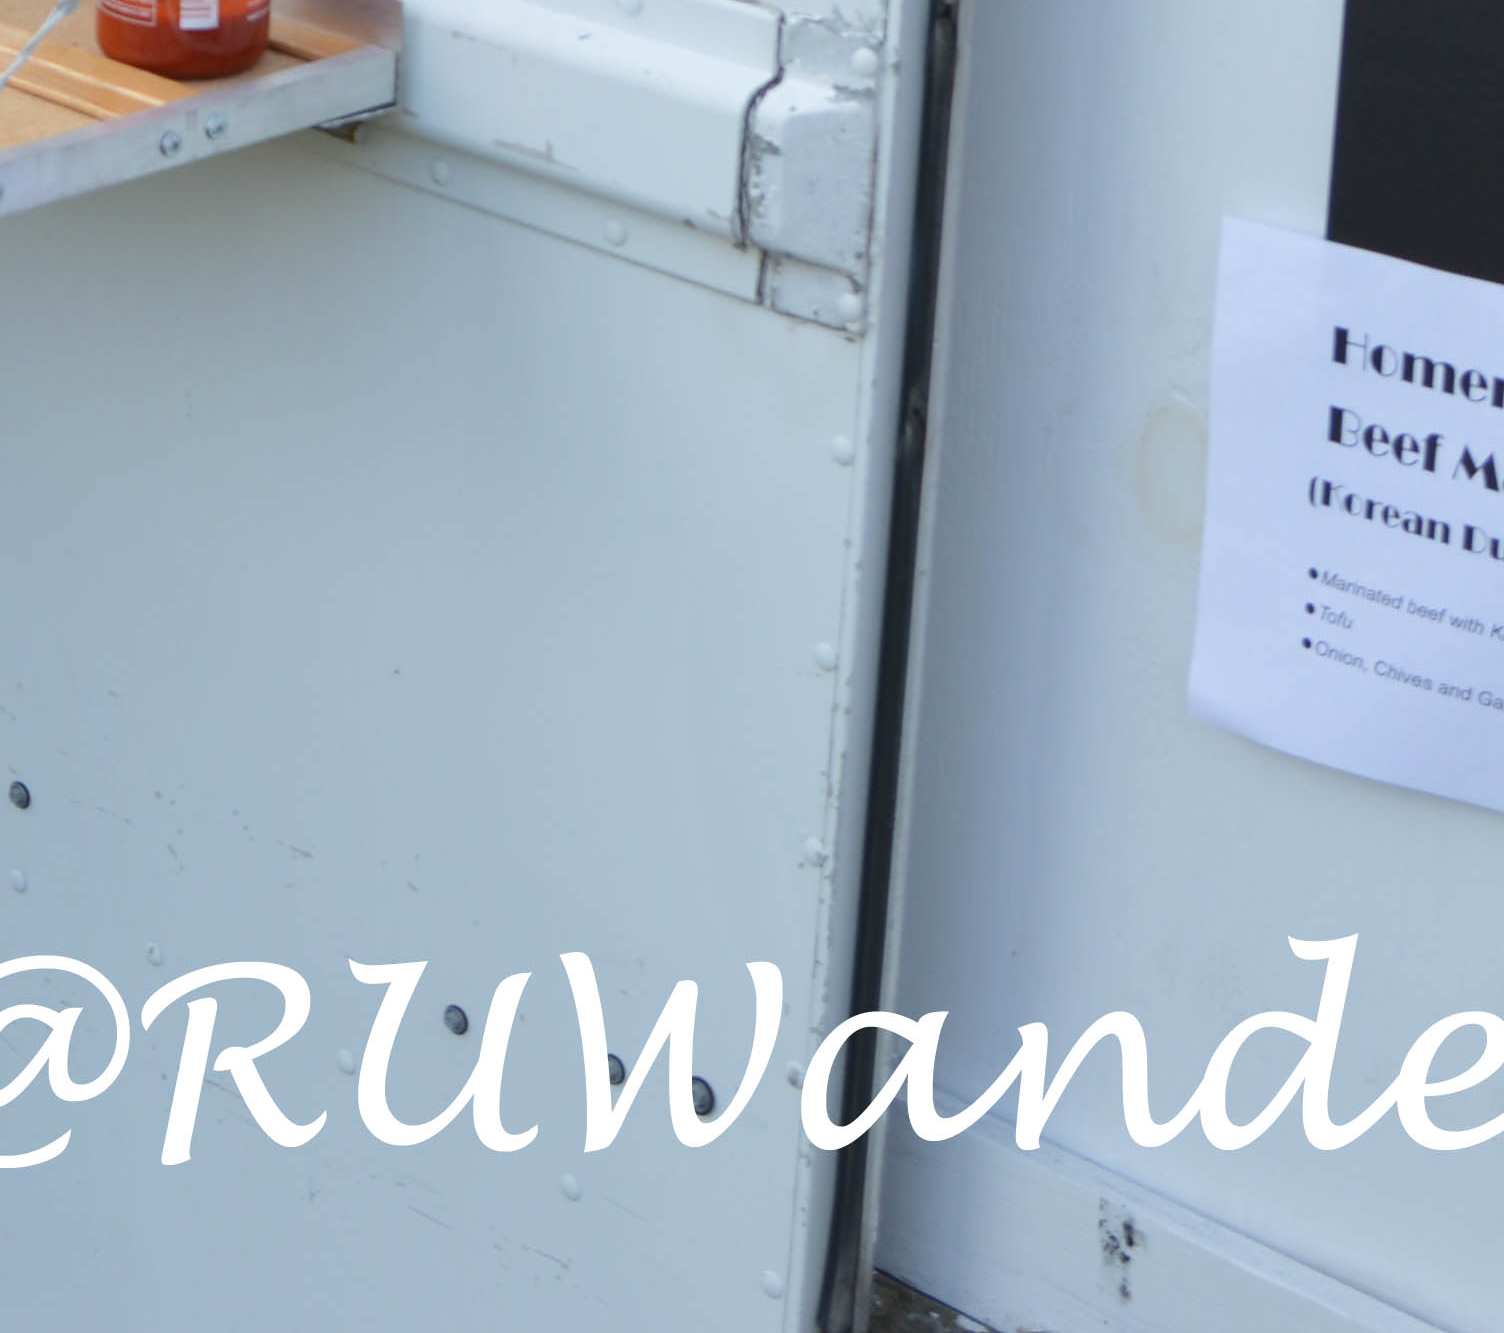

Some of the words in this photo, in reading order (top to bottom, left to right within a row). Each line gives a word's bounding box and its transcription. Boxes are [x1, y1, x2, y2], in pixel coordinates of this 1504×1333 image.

[1327, 404, 1442, 474] Beef
[1308, 475, 1452, 546] (Korean
[1319, 603, 1355, 631] Tofu
[1320, 569, 1405, 612] Marinated
[1406, 597, 1448, 625] beef
[1448, 614, 1486, 637] with
[1373, 658, 1434, 693] Chives
[1437, 681, 1475, 703] and
